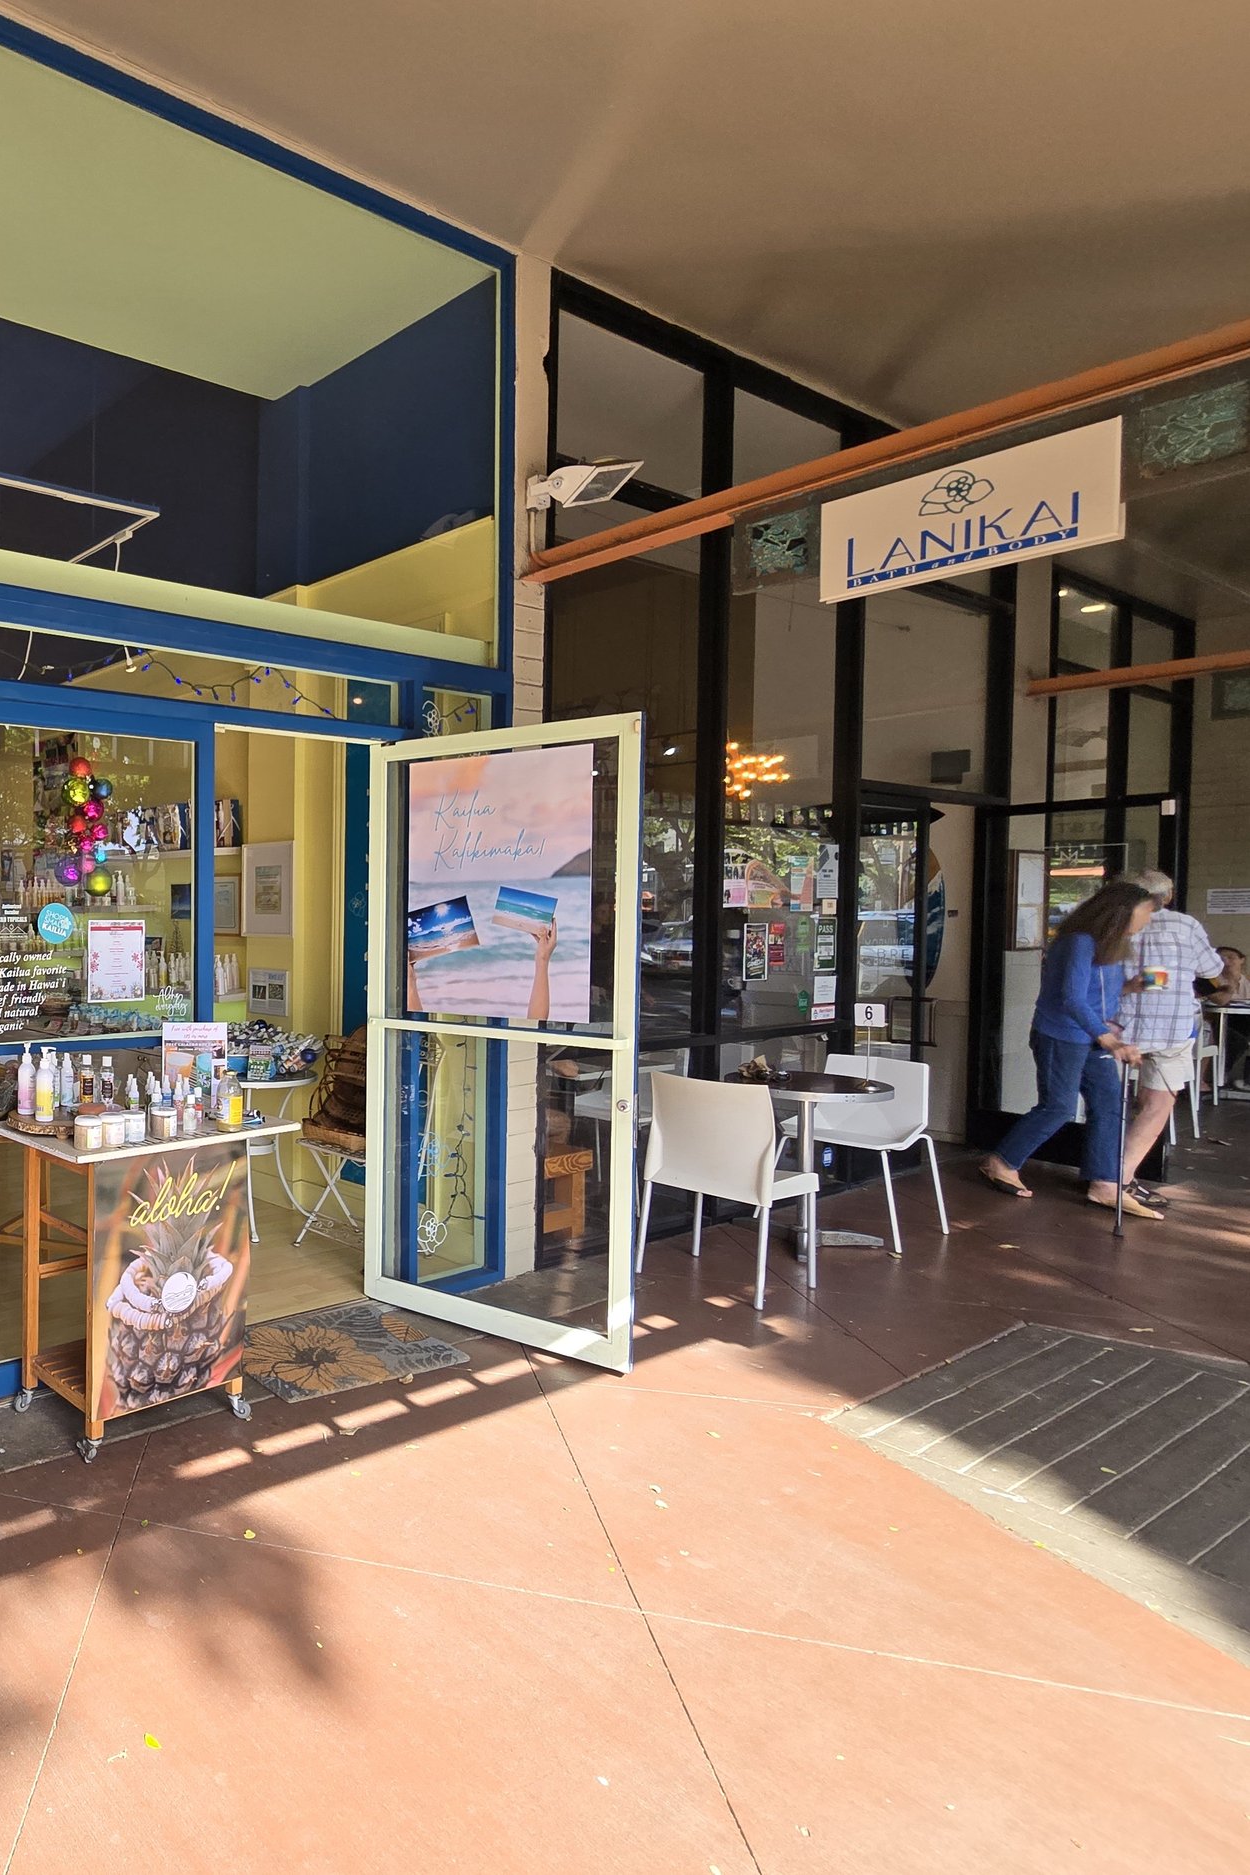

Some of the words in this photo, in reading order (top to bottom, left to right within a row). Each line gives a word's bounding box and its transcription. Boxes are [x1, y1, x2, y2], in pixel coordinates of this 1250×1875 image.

[847, 492, 1079, 578] LANIKAI
[853, 565, 916, 588] BATH
[931, 552, 972, 569] and
[988, 529, 1070, 556] BODY
[435, 789, 496, 831] Kailua
[434, 827, 546, 872] Kalikimaka!
[42, 923, 67, 937] KAILUA
[818, 924, 834, 933] PASS
[23, 950, 54, 962] owned
[31, 964, 68, 979] favorite
[17, 981, 27, 991] in
[10, 992, 47, 1007] friendly
[4, 1006, 40, 1018] natural
[864, 1005, 873, 1020] 6
[130, 1160, 236, 1227] aloha!
